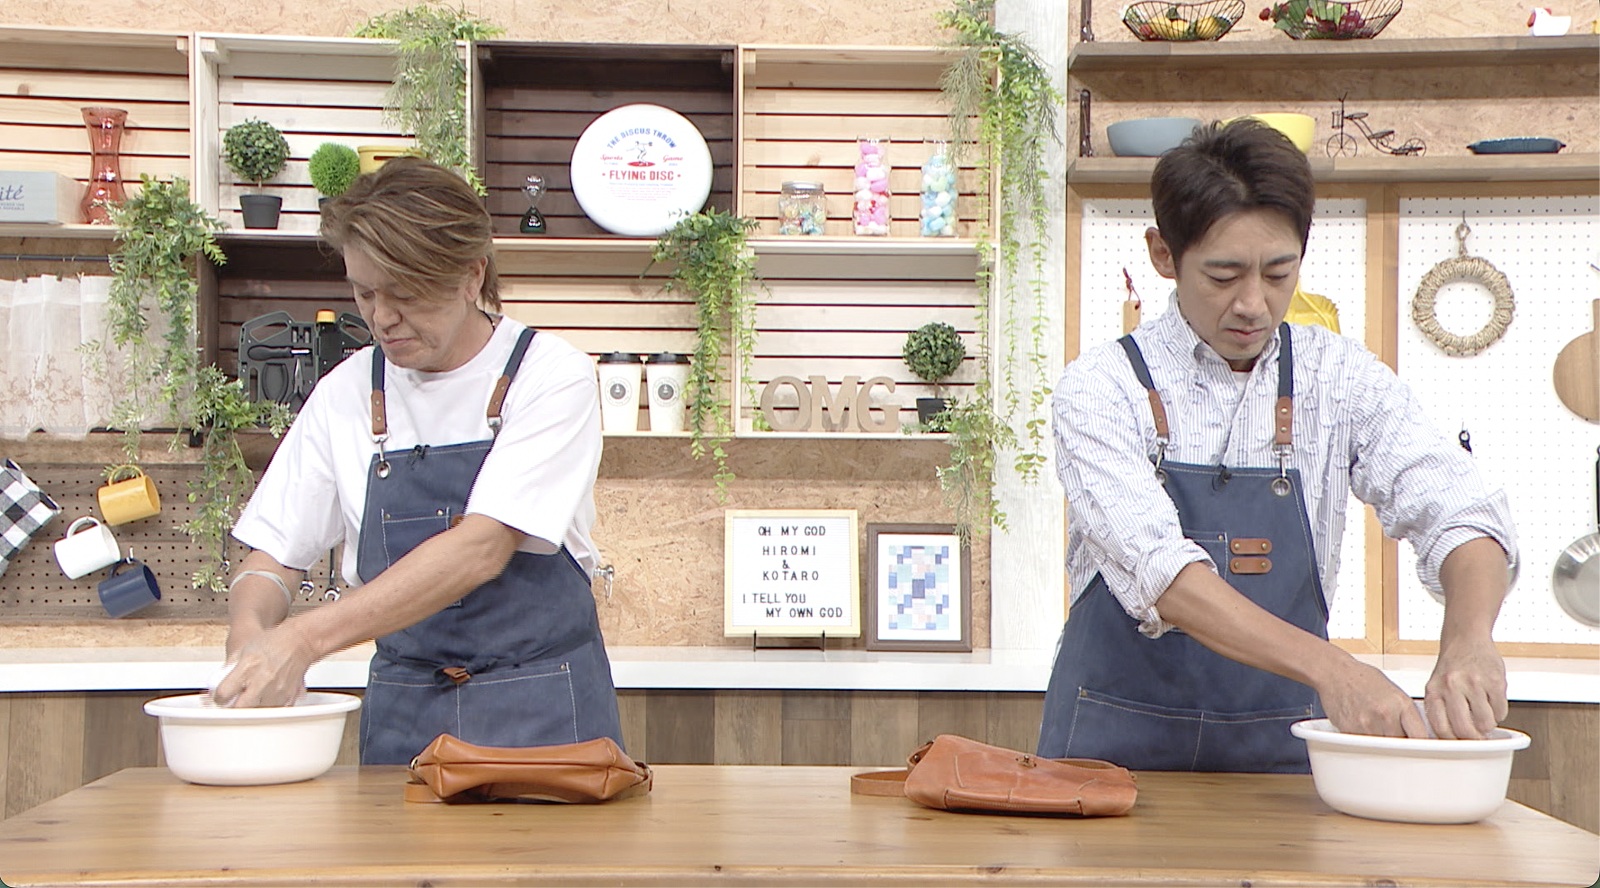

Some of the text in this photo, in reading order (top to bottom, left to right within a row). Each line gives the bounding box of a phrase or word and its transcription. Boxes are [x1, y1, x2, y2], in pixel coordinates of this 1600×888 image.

[620, 128, 651, 139] DISCUS
[653, 130, 677, 149] THROW
[609, 170, 674, 181] FLYING DISC
[760, 375, 902, 432] OMG
[758, 526, 826, 536] OH MY GOD
[762, 545, 816, 556] HIROMI
[782, 559, 790, 569] &
[763, 571, 819, 581] KOTARO
[752, 593, 781, 604] TELL
[785, 593, 806, 604] YOU
[766, 607, 843, 618] MY OWN GOD
